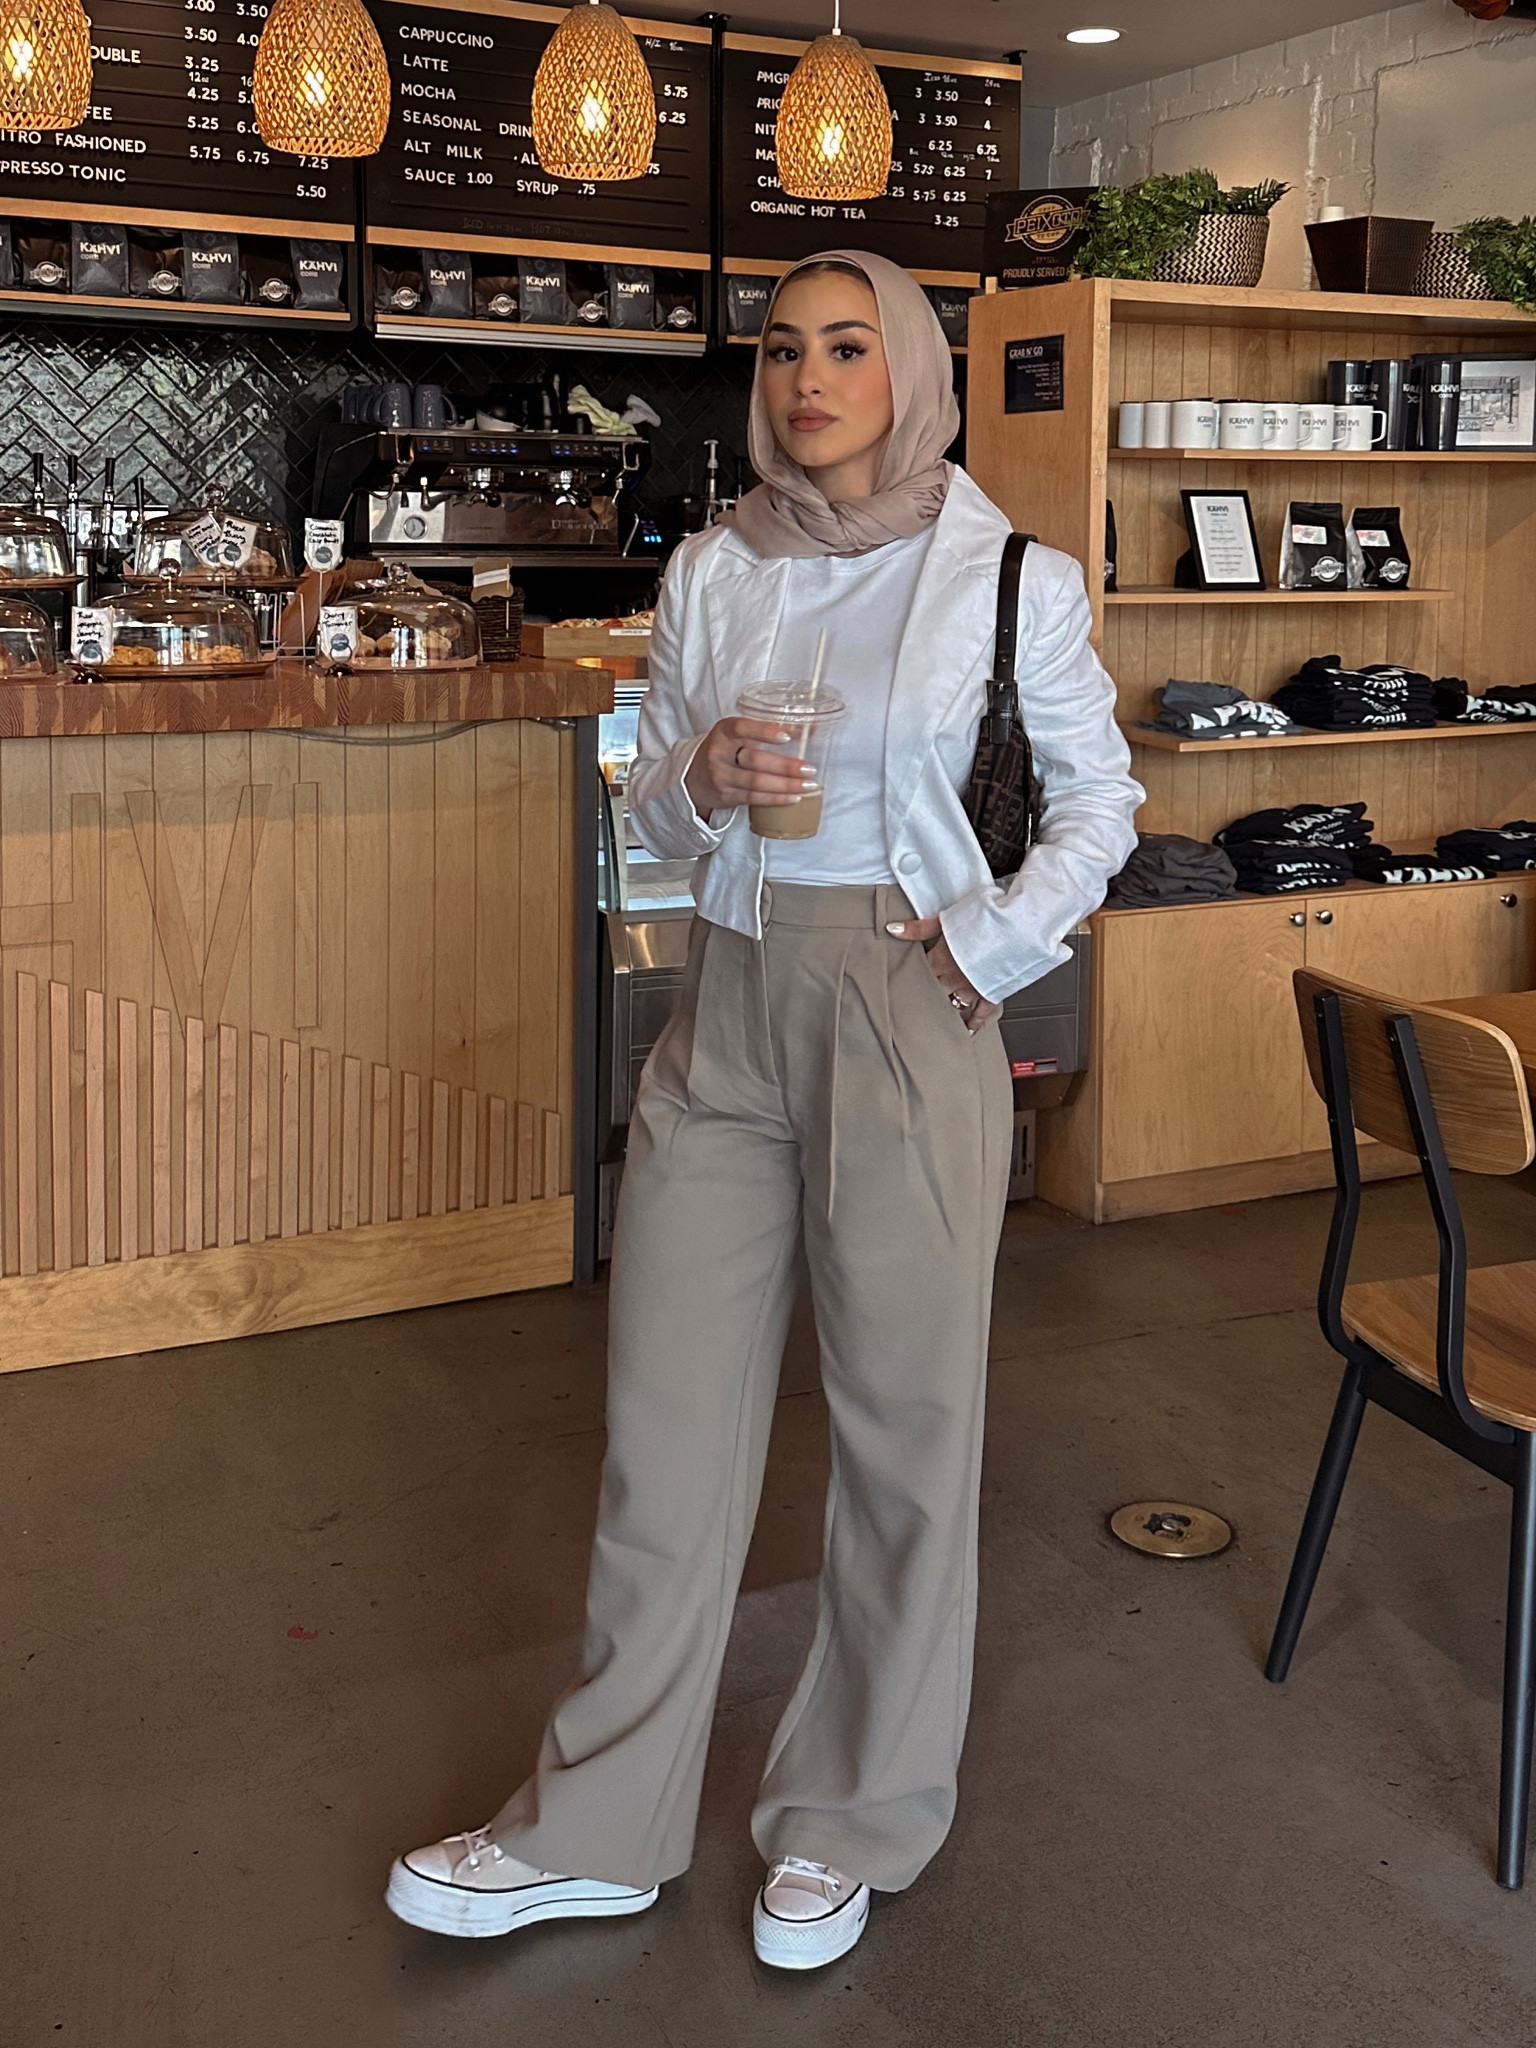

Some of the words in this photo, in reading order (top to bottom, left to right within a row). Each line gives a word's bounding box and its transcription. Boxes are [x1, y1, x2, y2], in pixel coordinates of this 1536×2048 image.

[236, 3, 268, 18] 3.50
[184, 26, 217, 42] 3.50
[236, 33, 259, 47] 4.0
[399, 26, 494, 49] CAPPUCCINO
[90, 45, 141, 63] OUBLE
[184, 56, 219, 72] 3.25
[403, 53, 449, 72] LATTE
[663, 84, 688, 98] 5.75
[187, 87, 219, 101] 4.25
[401, 82, 456, 101] MOCHA
[658, 111, 686, 124] 6.25
[915, 87, 922, 98] 3
[934, 90, 958, 102] 3.50
[984, 95, 992, 106] 4
[187, 116, 219, 130] 5.25
[236, 121, 261, 134] 6.0
[402, 109, 482, 132] SEASONAL
[499, 123, 532, 138] DRIN
[918, 113, 926, 124] 3
[935, 114, 958, 126] 3.50
[983, 119, 991, 131] 4
[0, 128, 42, 144] ITRO
[55, 132, 147, 153] FASHIONED
[189, 146, 221, 160] 5.75
[236, 150, 270, 165] 6.75
[298, 155, 329, 170] 7.25
[404, 139, 431, 154] ALT
[446, 144, 483, 160] MILK
[755, 123, 776, 136] NIT
[928, 140, 953, 151] 6.25
[976, 144, 997, 156] 6.75
[0, 160, 64, 175] PRESSO
[69, 165, 127, 182] TONIC
[296, 184, 327, 199] 5.50
[404, 168, 456, 186] SAUCE
[467, 172, 493, 185] 1.00
[516, 180, 559, 196] SYRUP
[578, 183, 596, 195] .75
[944, 166, 966, 177] 6.25
[913, 189, 936, 202] 5.75
[943, 191, 966, 202] 6.25
[750, 201, 806, 216] ORGANIC
[811, 205, 836, 217] HOT
[842, 207, 866, 219] TEA
[934, 214, 959, 227] 3.25
[1002, 268, 1036, 279] PROUDLY
[1036, 267, 1065, 278] SERVED
